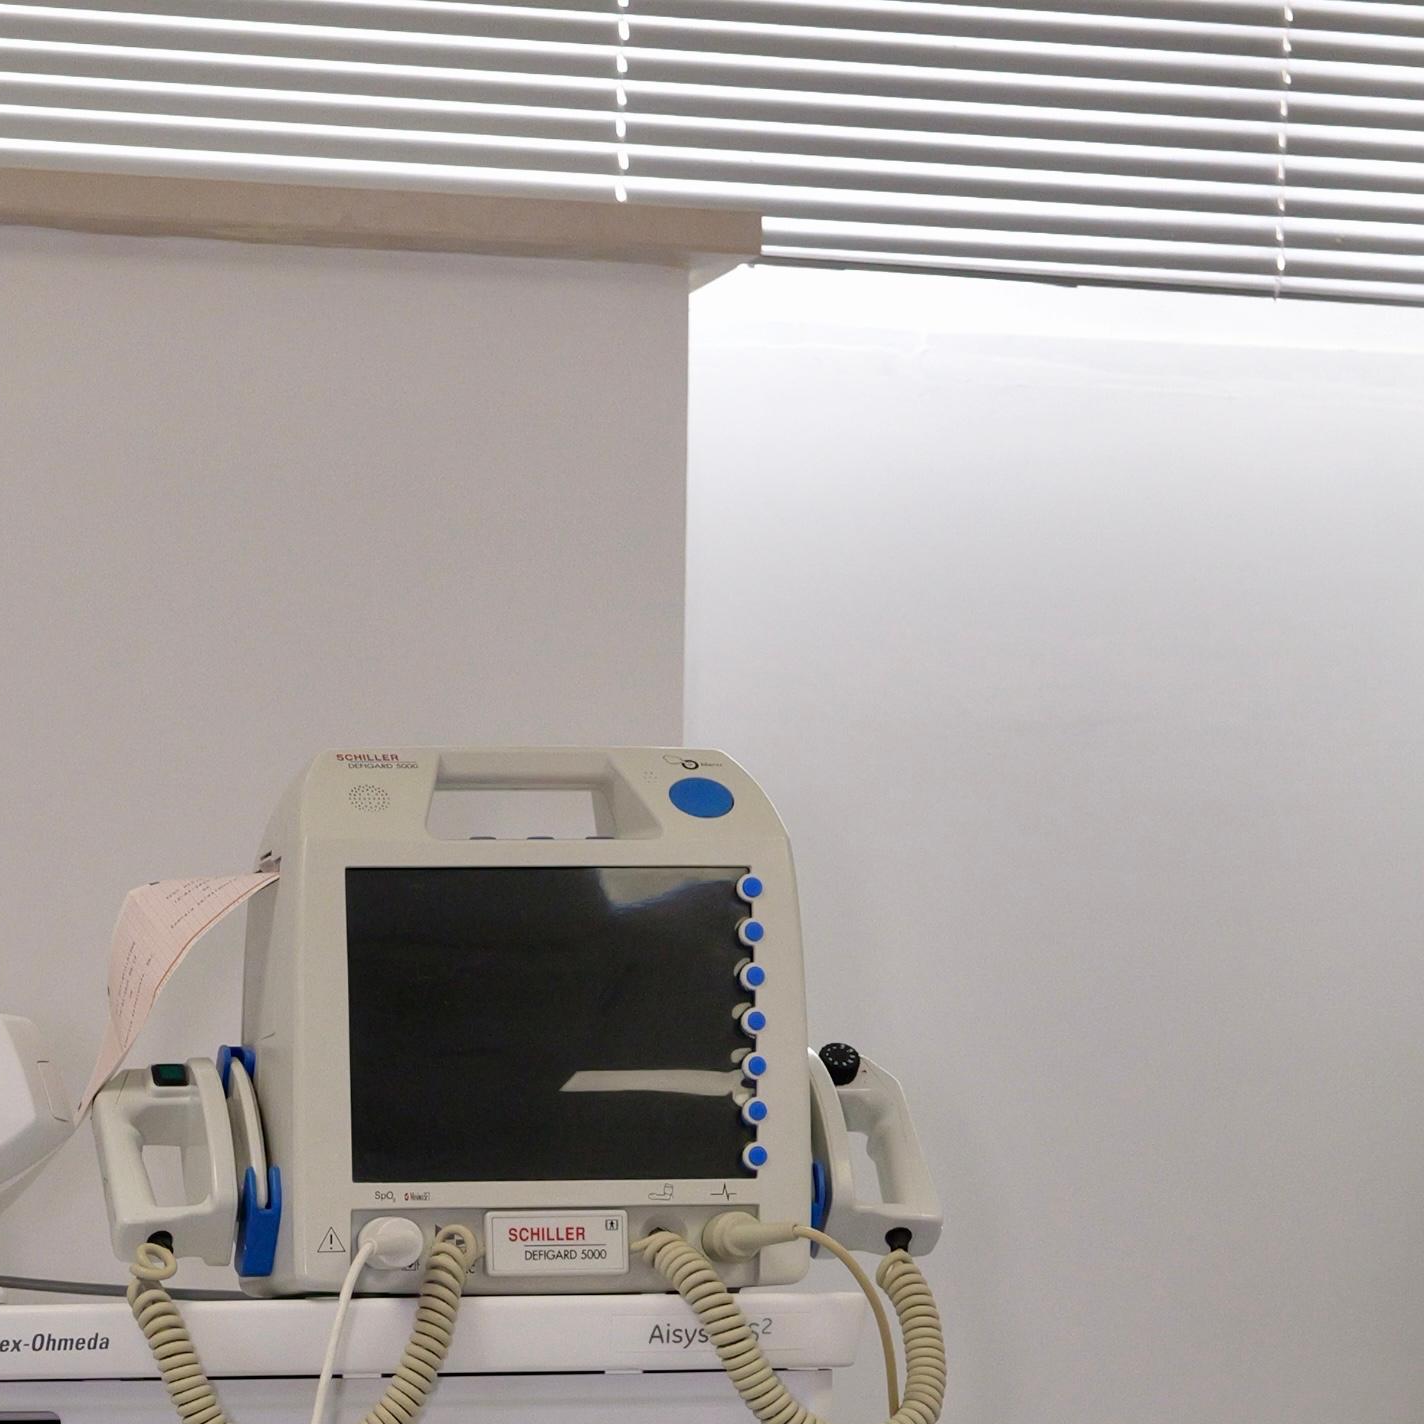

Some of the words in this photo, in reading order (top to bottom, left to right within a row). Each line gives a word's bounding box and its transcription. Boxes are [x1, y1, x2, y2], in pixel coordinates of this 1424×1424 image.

[336, 753, 400, 761] SCHILLER
[508, 1227, 586, 1242] SCHILLER
[524, 1249, 578, 1261] DEFIGARD
[580, 1248, 607, 1260] 5000
[648, 1323, 710, 1349] Aisys
